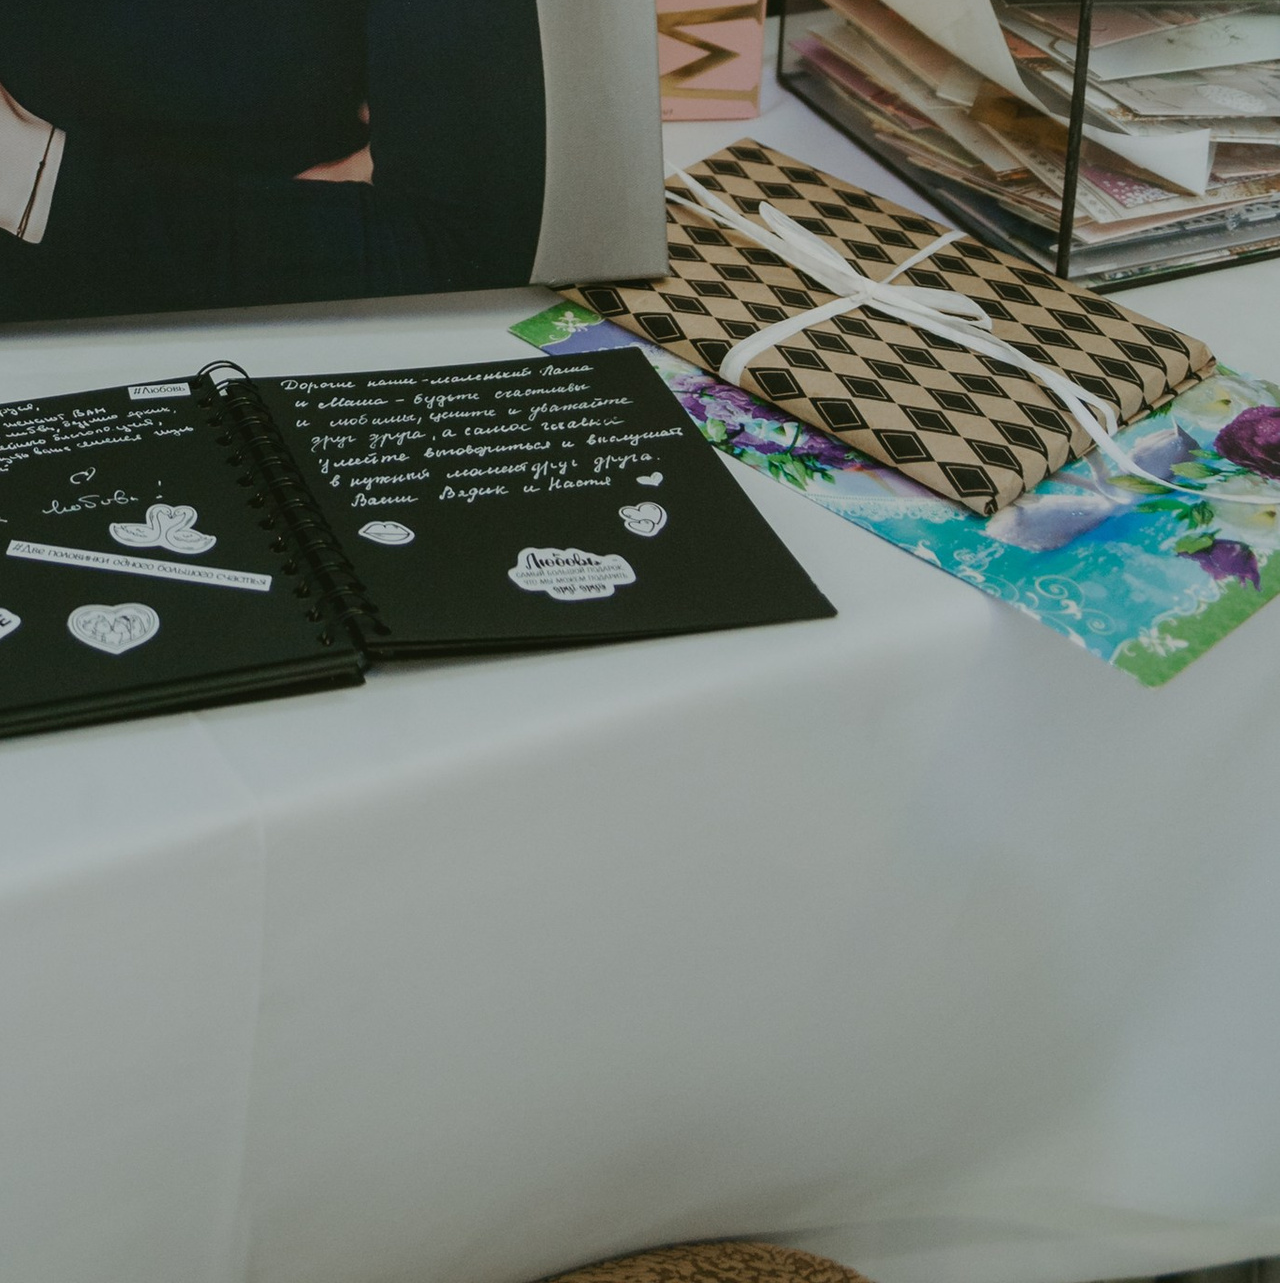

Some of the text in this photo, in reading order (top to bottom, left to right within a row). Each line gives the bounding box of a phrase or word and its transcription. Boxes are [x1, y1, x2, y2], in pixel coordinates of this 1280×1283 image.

[133, 383, 187, 395] #Любовь
[12, 543, 267, 586] #Две половинки одного большого счастья
[525, 552, 602, 570] Любовь
[516, 568, 545, 578] САМЫЙ
[547, 567, 585, 576] БОЛЬШОЙ
[555, 575, 587, 584] МОЖЕМ
[588, 572, 628, 582] ПОДАРИТЬ
